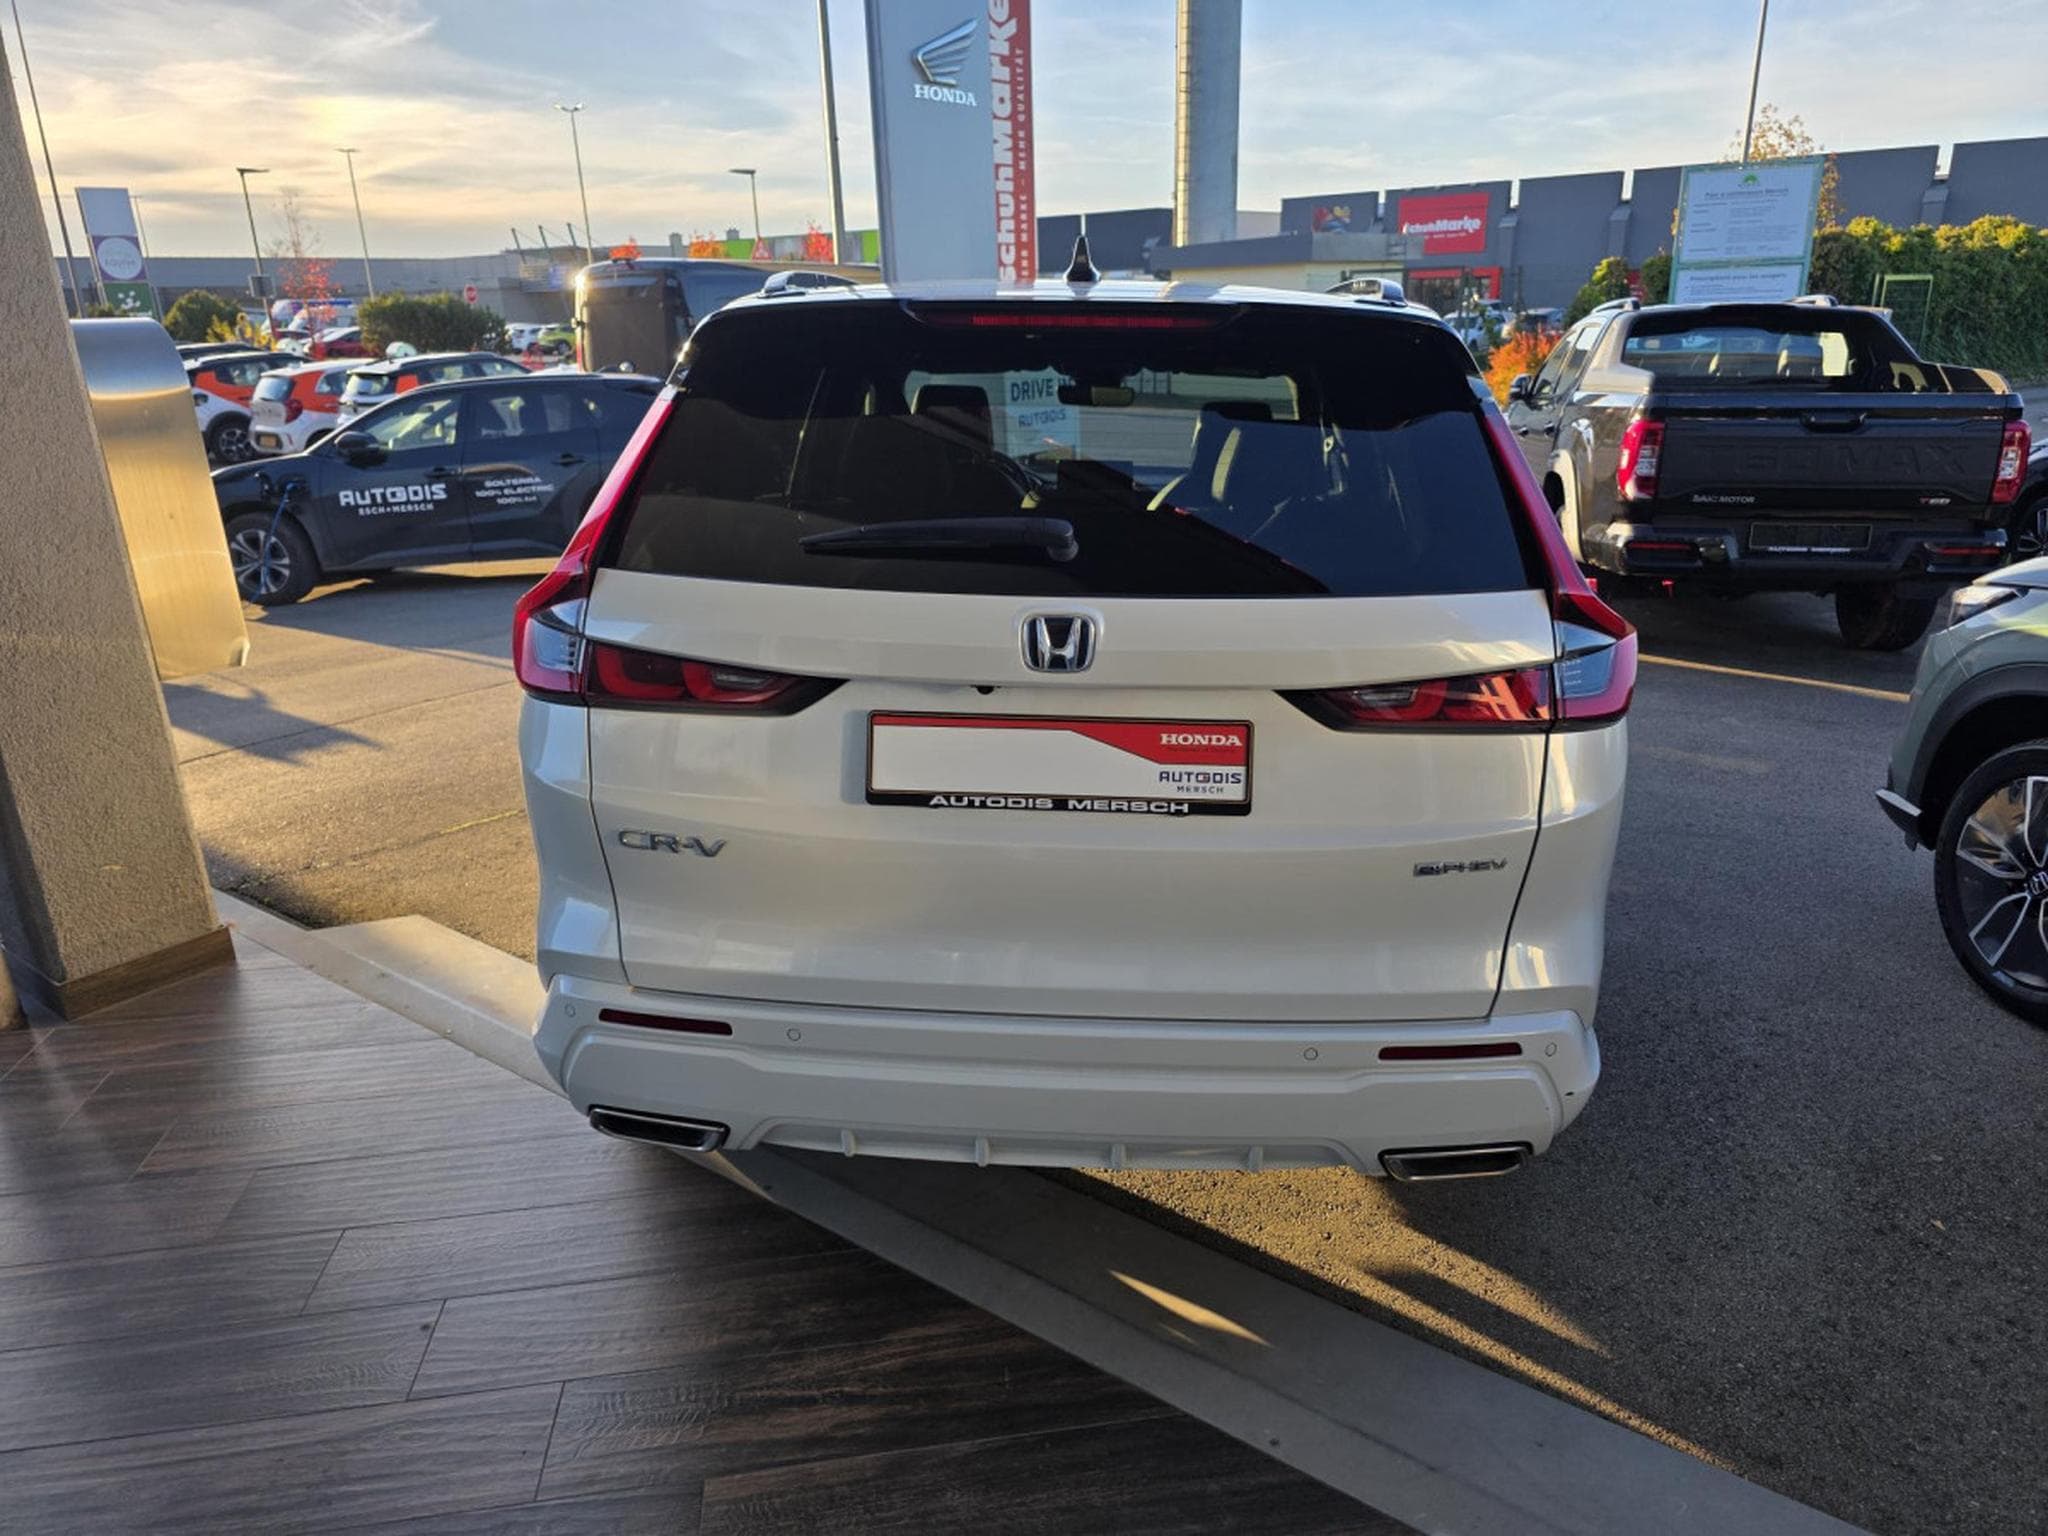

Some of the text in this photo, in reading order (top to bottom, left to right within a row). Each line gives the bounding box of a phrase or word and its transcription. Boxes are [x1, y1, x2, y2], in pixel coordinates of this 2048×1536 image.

[914, 84, 977, 107] HONDA
[1015, 48, 1026, 122] QUALITÄT
[1018, 130, 1026, 170] MEHR
[1019, 195, 1028, 242] MARKE
[1010, 379, 1054, 402] DRIVE
[339, 483, 447, 507] AUTODIS
[1160, 733, 1243, 747] HONDA
[1159, 770, 1242, 784] AUTODIS
[1176, 785, 1225, 794] MERSCH
[929, 795, 1189, 814] AUTODIS MERSCH
[618, 830, 727, 857] CR-V
